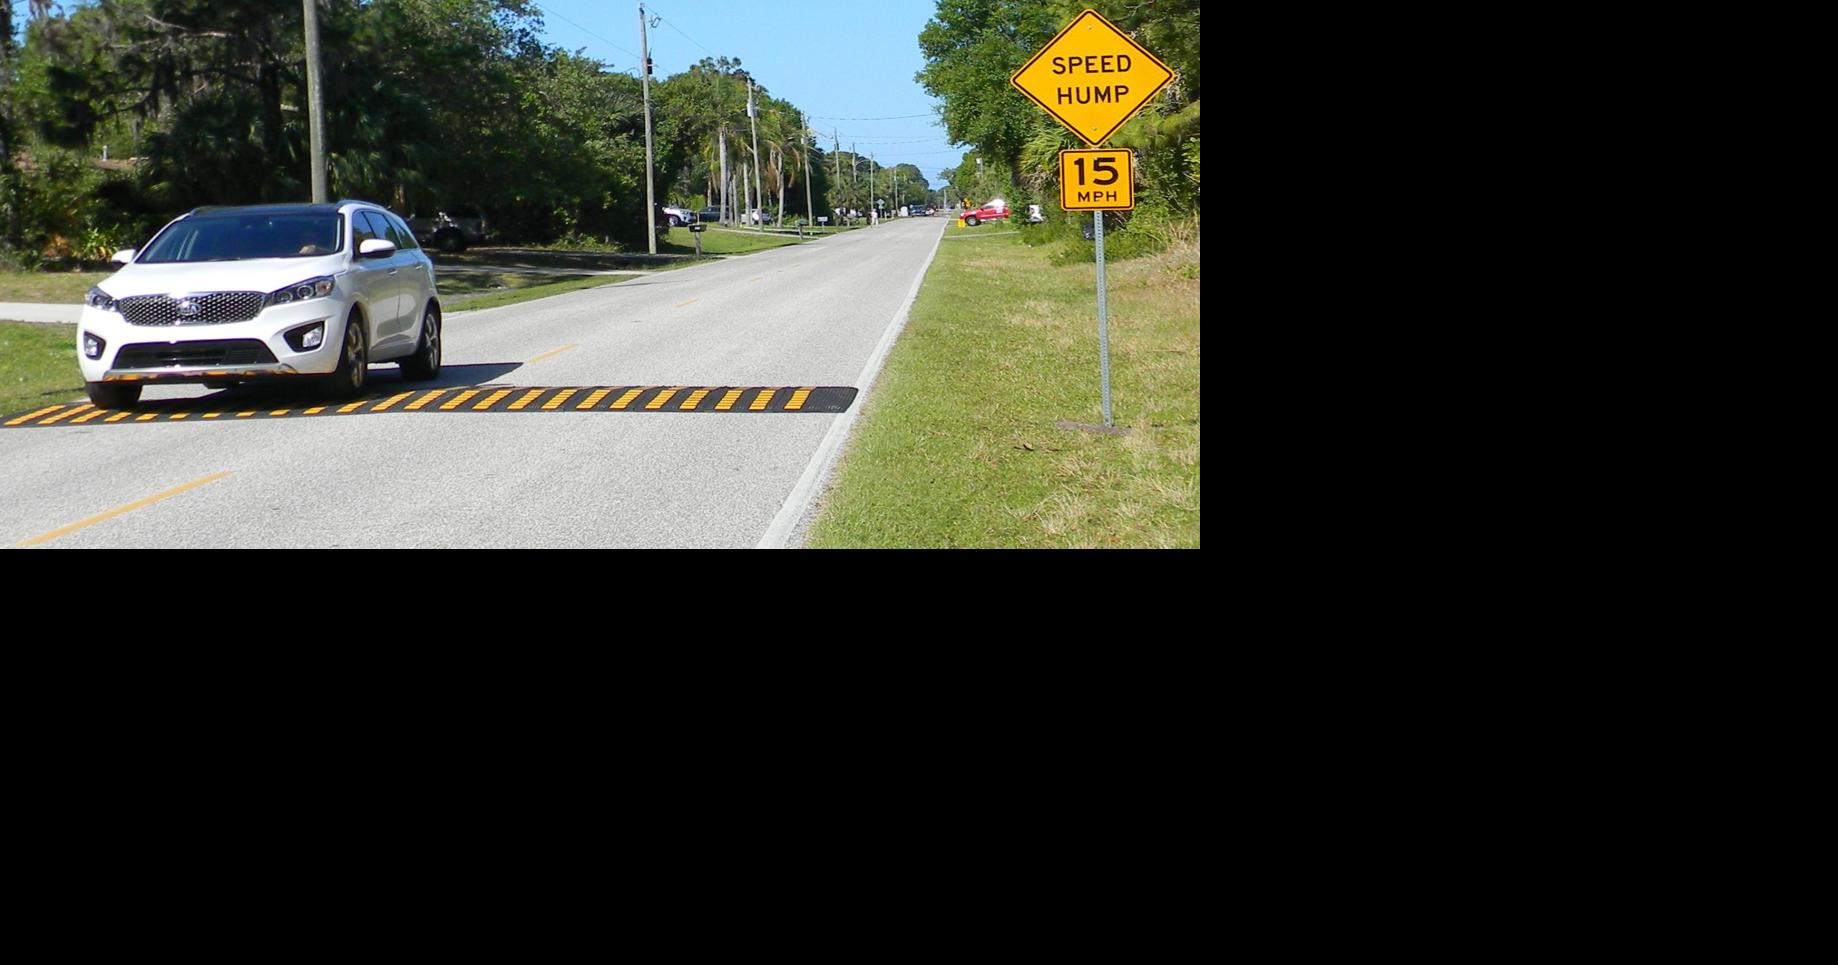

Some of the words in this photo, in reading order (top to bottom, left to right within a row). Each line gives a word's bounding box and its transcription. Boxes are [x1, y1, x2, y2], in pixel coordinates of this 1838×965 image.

[1052, 55, 1132, 75] SPEED
[1057, 85, 1129, 105] HUMP
[1073, 156, 1119, 186] 15
[1077, 191, 1117, 203] MPH
